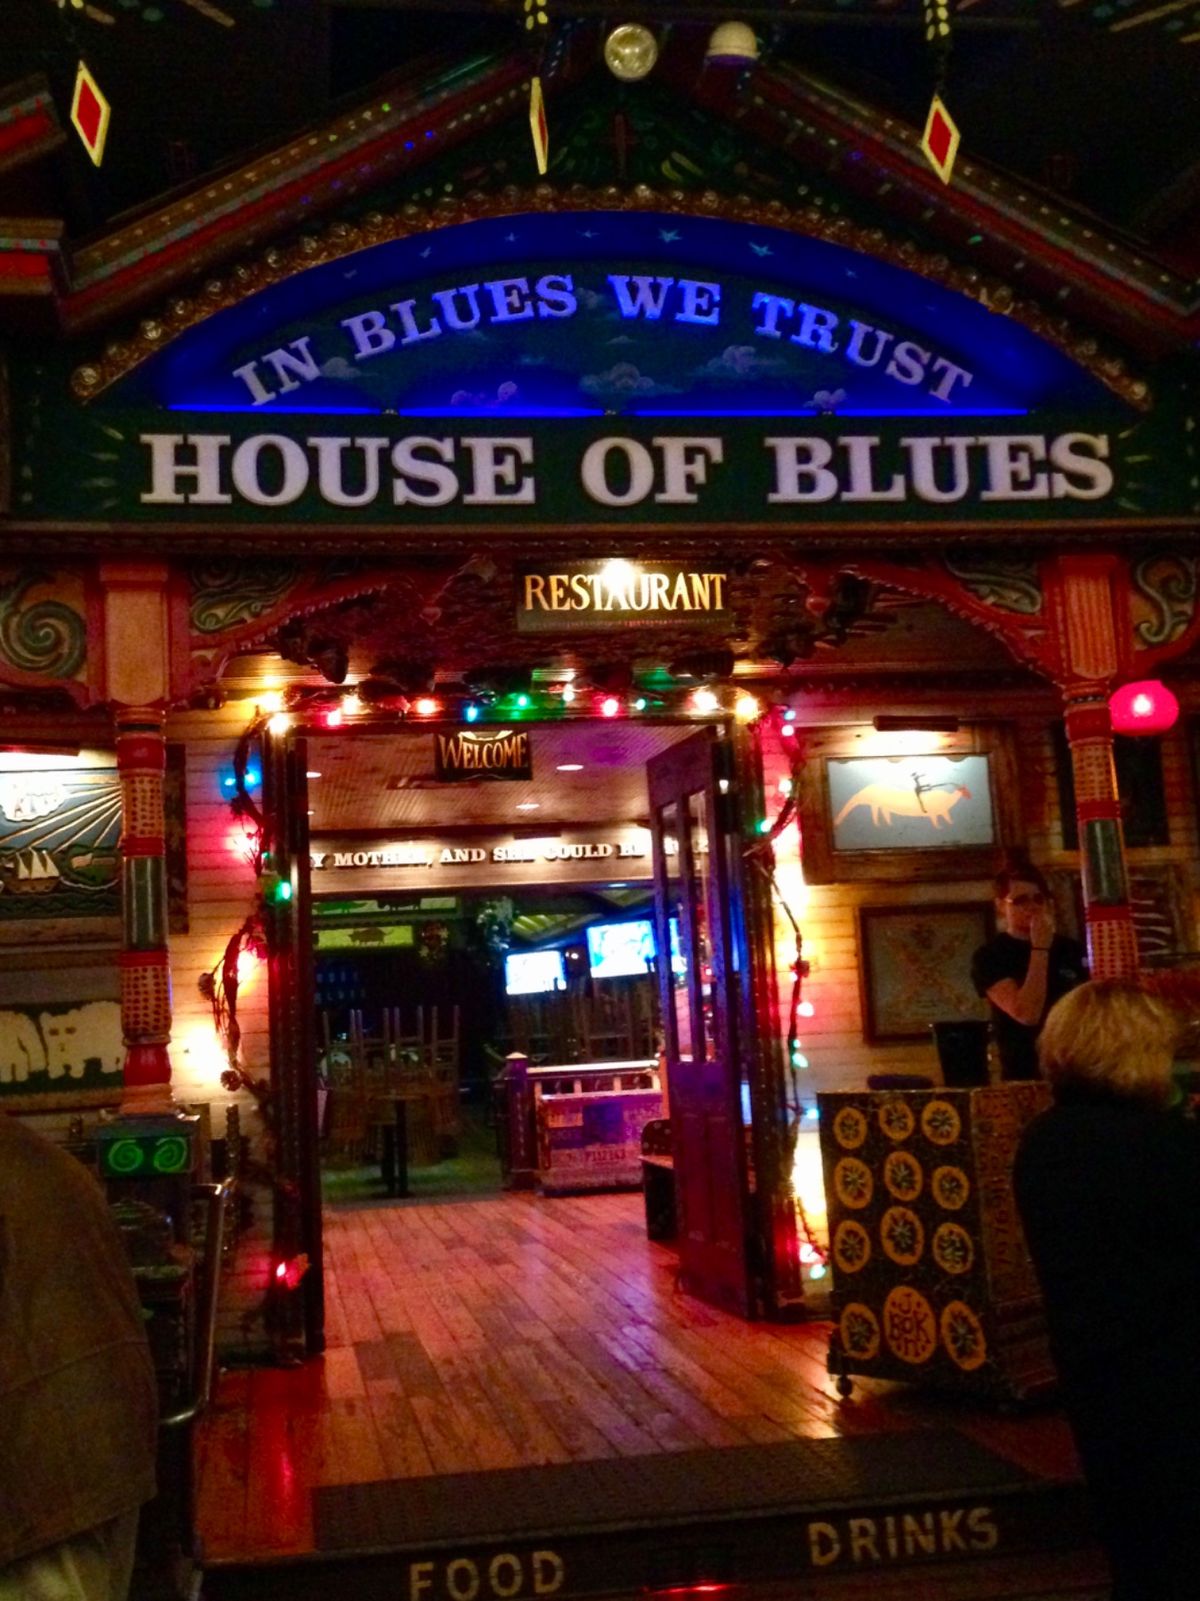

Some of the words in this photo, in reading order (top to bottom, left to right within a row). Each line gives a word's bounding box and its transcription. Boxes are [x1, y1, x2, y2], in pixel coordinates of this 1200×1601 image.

[232, 336, 322, 406] IN
[341, 274, 577, 360] BLUES
[607, 275, 721, 326] WE
[752, 291, 973, 405] TRUST
[140, 433, 536, 507] HOUSE
[581, 436, 724, 507] OF
[764, 430, 1115, 505] BLUES
[525, 571, 728, 612] RESTAURANT
[438, 732, 529, 769] WELCOME
[310, 852, 328, 869] Y
[333, 848, 434, 869] MOTH,
[440, 847, 486, 865] AND
[808, 1506, 999, 1567] DRINKS
[409, 1550, 565, 1601] FOOD
